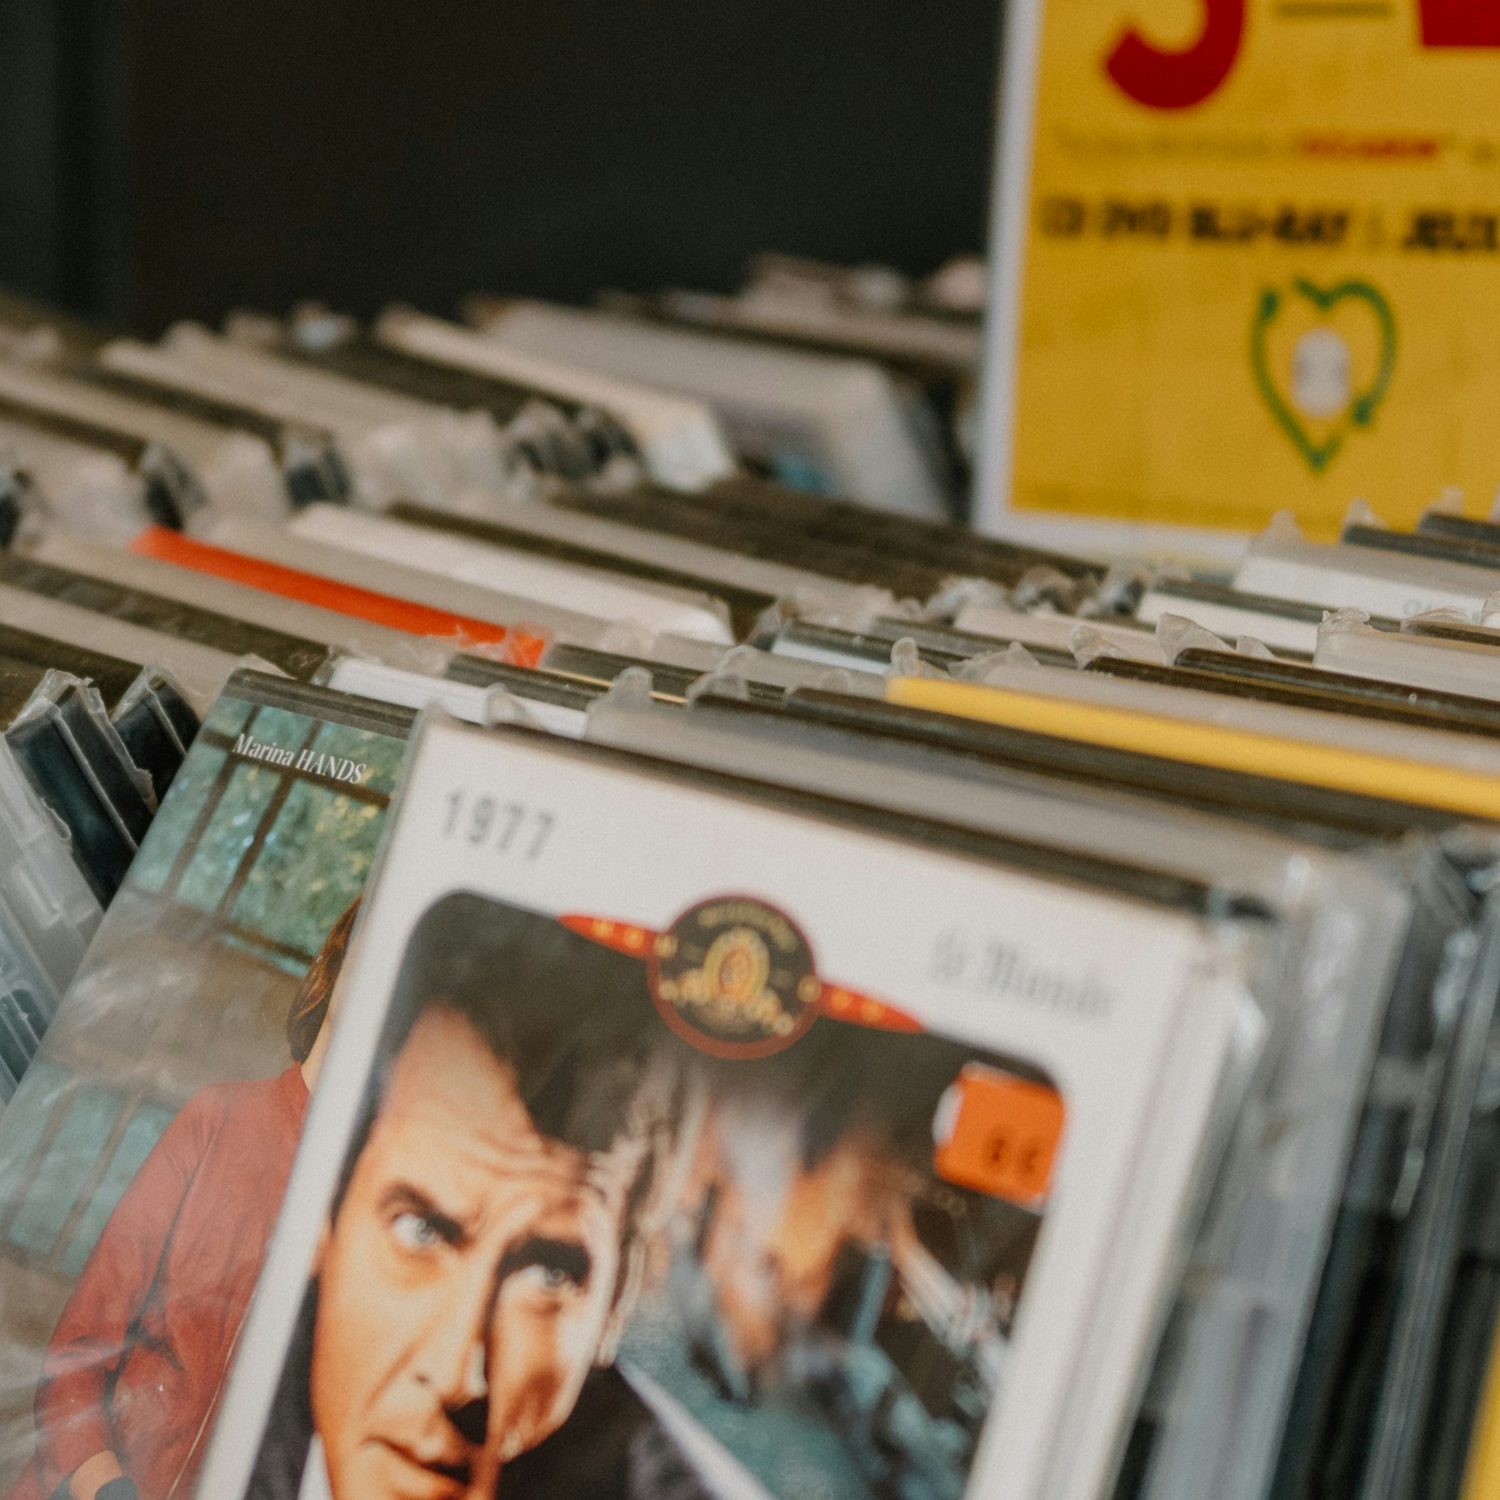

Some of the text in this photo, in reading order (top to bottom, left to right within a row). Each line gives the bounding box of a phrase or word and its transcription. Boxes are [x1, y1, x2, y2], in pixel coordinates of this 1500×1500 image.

[1404, 208, 1500, 255] JEUX
[231, 732, 368, 786] Marina HANDS
[440, 787, 556, 862] 1977
